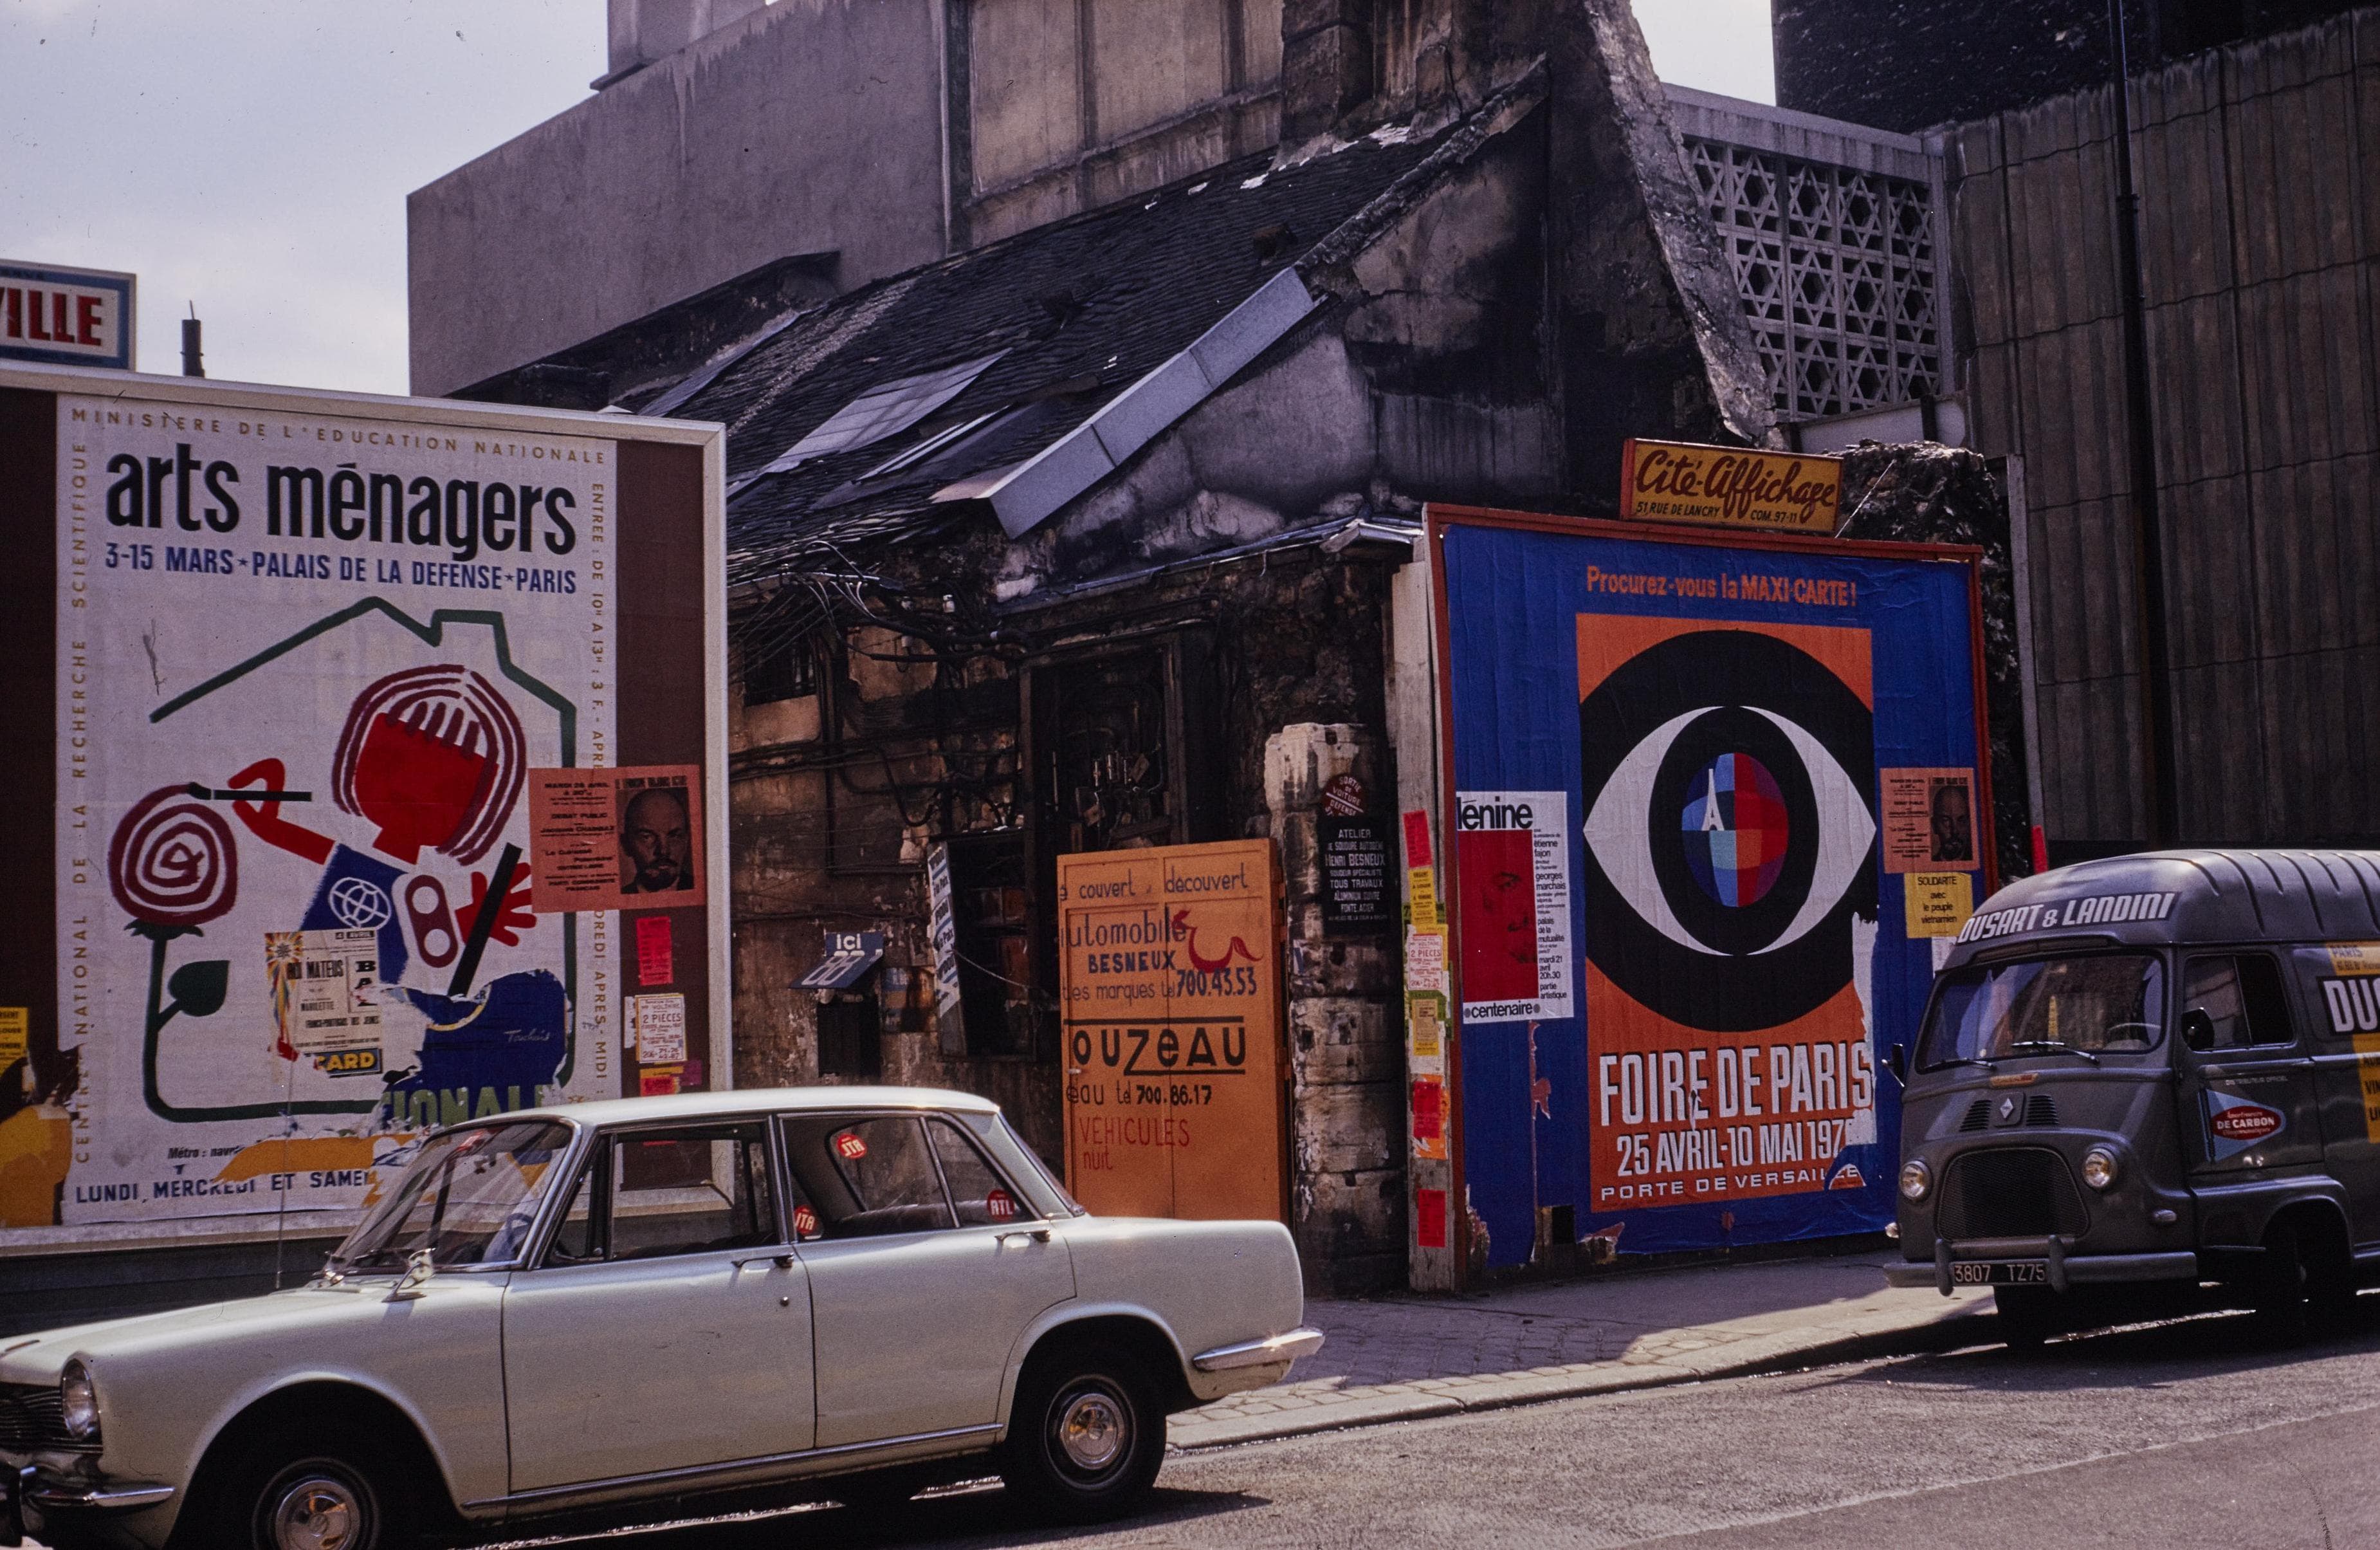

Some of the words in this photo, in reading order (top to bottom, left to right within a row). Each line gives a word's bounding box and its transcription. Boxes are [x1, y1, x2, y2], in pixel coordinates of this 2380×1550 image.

[71, 408, 221, 432] MINISTERE
[239, 421, 265, 437] DE
[476, 441, 604, 464] NATIONALE
[105, 443, 240, 533] arts
[266, 462, 576, 562] ménagers
[1671, 504, 1684, 516] DE
[71, 443, 86, 608] SCIENTIFIQUE
[105, 542, 154, 571] 3-15
[165, 546, 234, 577] MARS
[252, 551, 331, 581] PALAIS
[340, 556, 367, 582] DE
[377, 558, 403, 584] LA
[412, 561, 503, 591] DEFENSE
[517, 567, 576, 595] PARIS
[591, 560, 605, 580] DE
[1721, 573, 1737, 599] la
[72, 641, 87, 778] RECHERCHE
[73, 804, 86, 829] LA
[1338, 829, 1371, 838] ATELIER
[73, 858, 86, 884] DE
[1348, 853, 1386, 867] BESNEUX
[1079, 869, 1136, 900] couvert
[1330, 880, 1348, 889] TOUS
[1351, 879, 1384, 888] TRAVAUX
[2042, 909, 2059, 928] &
[2062, 892, 2175, 926] LANDINI
[1088, 950, 1176, 973] BESNEUX
[1418, 949, 1442, 957] PIECES
[74, 916, 87, 1035] NATIONAL
[1096, 982, 1155, 1006] marques
[1176, 966, 1258, 999] 700.43.53
[652, 1013, 682, 1023] PIECES
[1471, 999, 1533, 1020] centenaire
[1599, 1050, 1710, 1127] FOIRE
[1716, 1046, 1762, 1118] DE
[1769, 1041, 1874, 1115] PARIS
[1079, 1116, 1191, 1148] VEHICULES
[2217, 1120, 2231, 1130] DE
[2232, 1117, 2275, 1129] CARBON
[167, 1147, 199, 1160] Métro
[1616, 1133, 1651, 1177] 25
[1759, 1121, 1804, 1165] MAI
[272, 1172, 297, 1191] ET
[1600, 1180, 1685, 1202] PORTE
[1696, 1177, 1727, 1194] DE
[1954, 1264, 1991, 1282] 3807
[2007, 1264, 2045, 1282] TZ75
